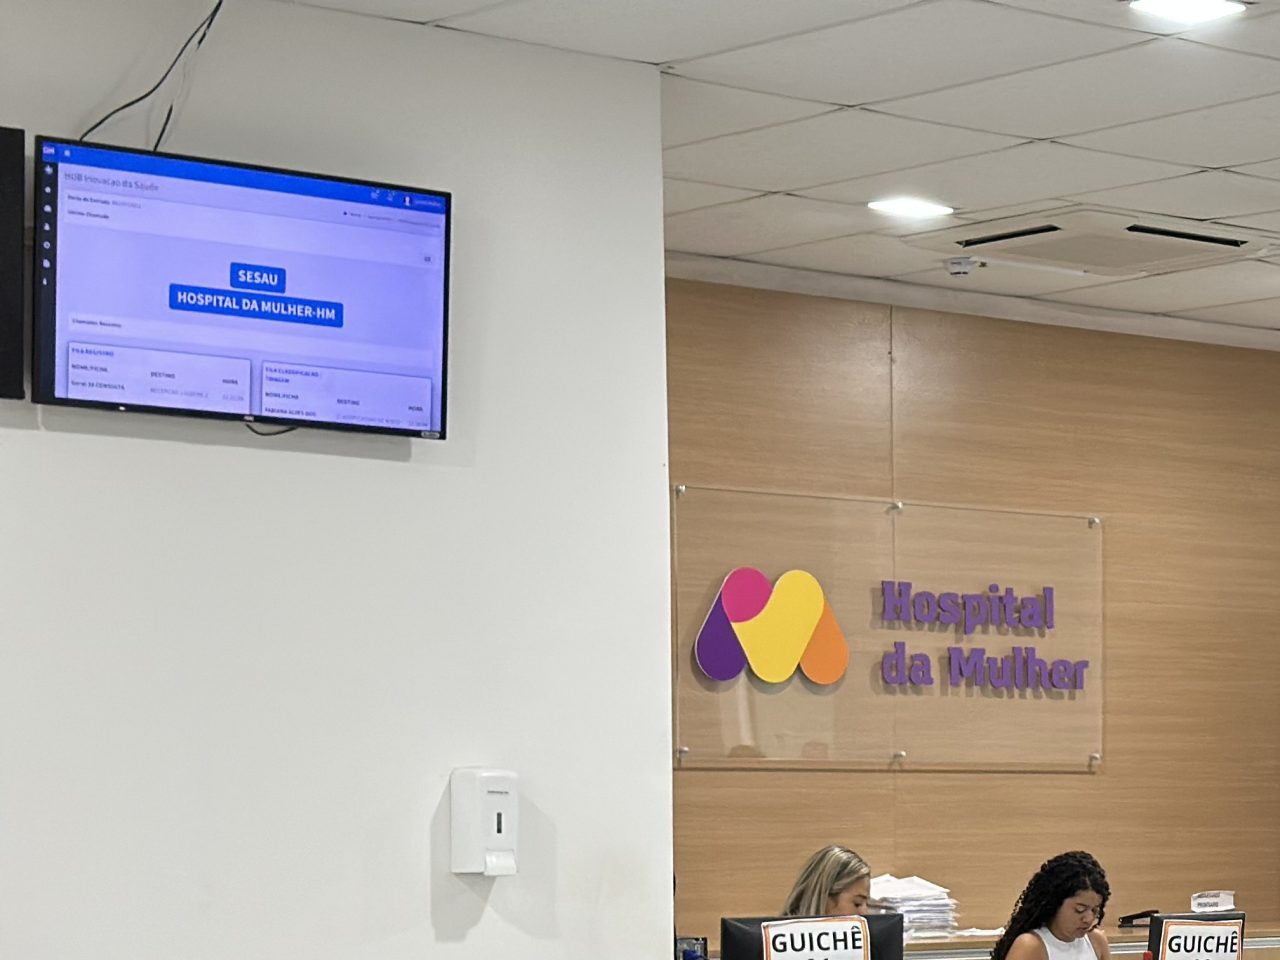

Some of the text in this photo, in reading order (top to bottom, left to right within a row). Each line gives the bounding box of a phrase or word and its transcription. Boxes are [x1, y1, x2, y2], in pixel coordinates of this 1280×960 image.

[238, 269, 278, 286] SESAU
[177, 290, 240, 310] HOSPITAL
[242, 298, 259, 311] DA
[881, 580, 1055, 635] Hospital
[881, 641, 1089, 690] da Mulher
[771, 925, 863, 953] GUICHÊ
[1168, 930, 1238, 953] GUICHÊ
